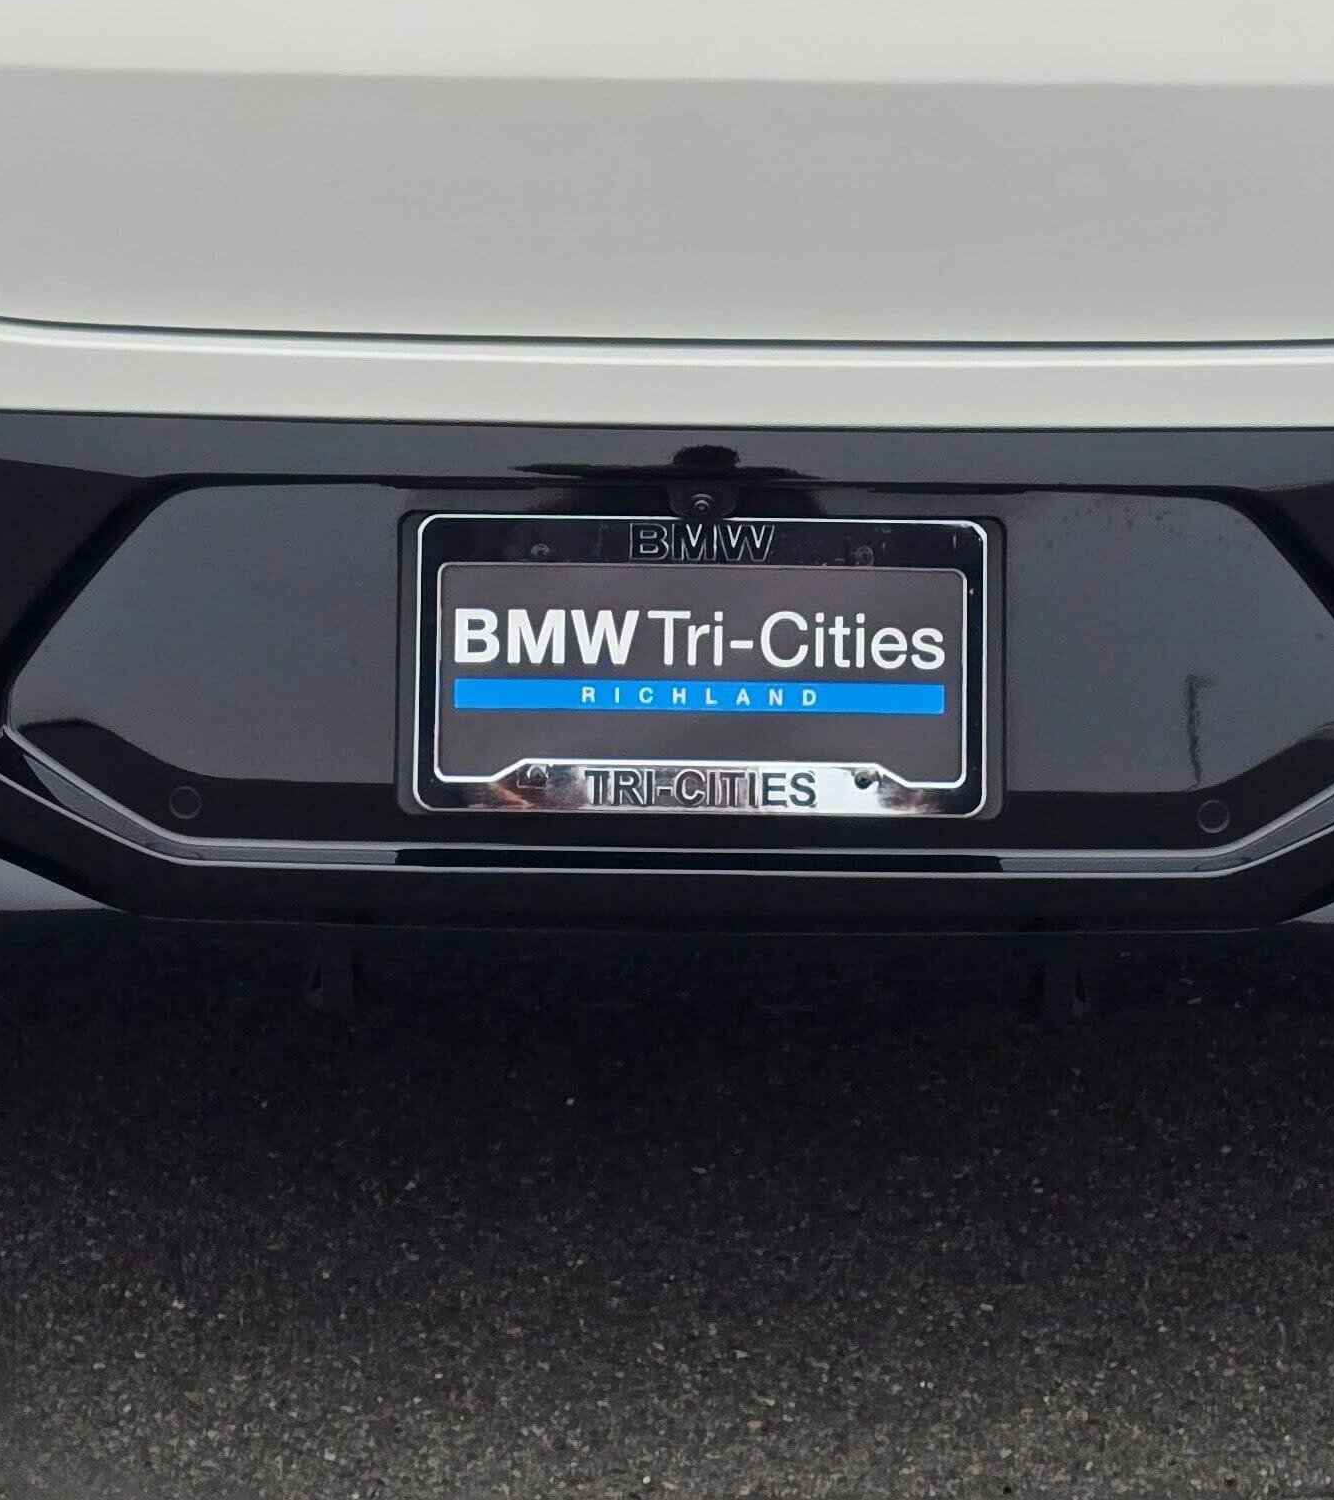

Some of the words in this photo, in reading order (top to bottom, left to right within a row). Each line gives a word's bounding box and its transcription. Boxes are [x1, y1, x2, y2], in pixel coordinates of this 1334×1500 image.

[629, 522, 775, 562] BMW
[453, 607, 641, 665] BMW
[646, 609, 946, 669] Tri-Cities
[581, 685, 819, 708] RICHLAND
[584, 767, 818, 807] TRI-CITIES
